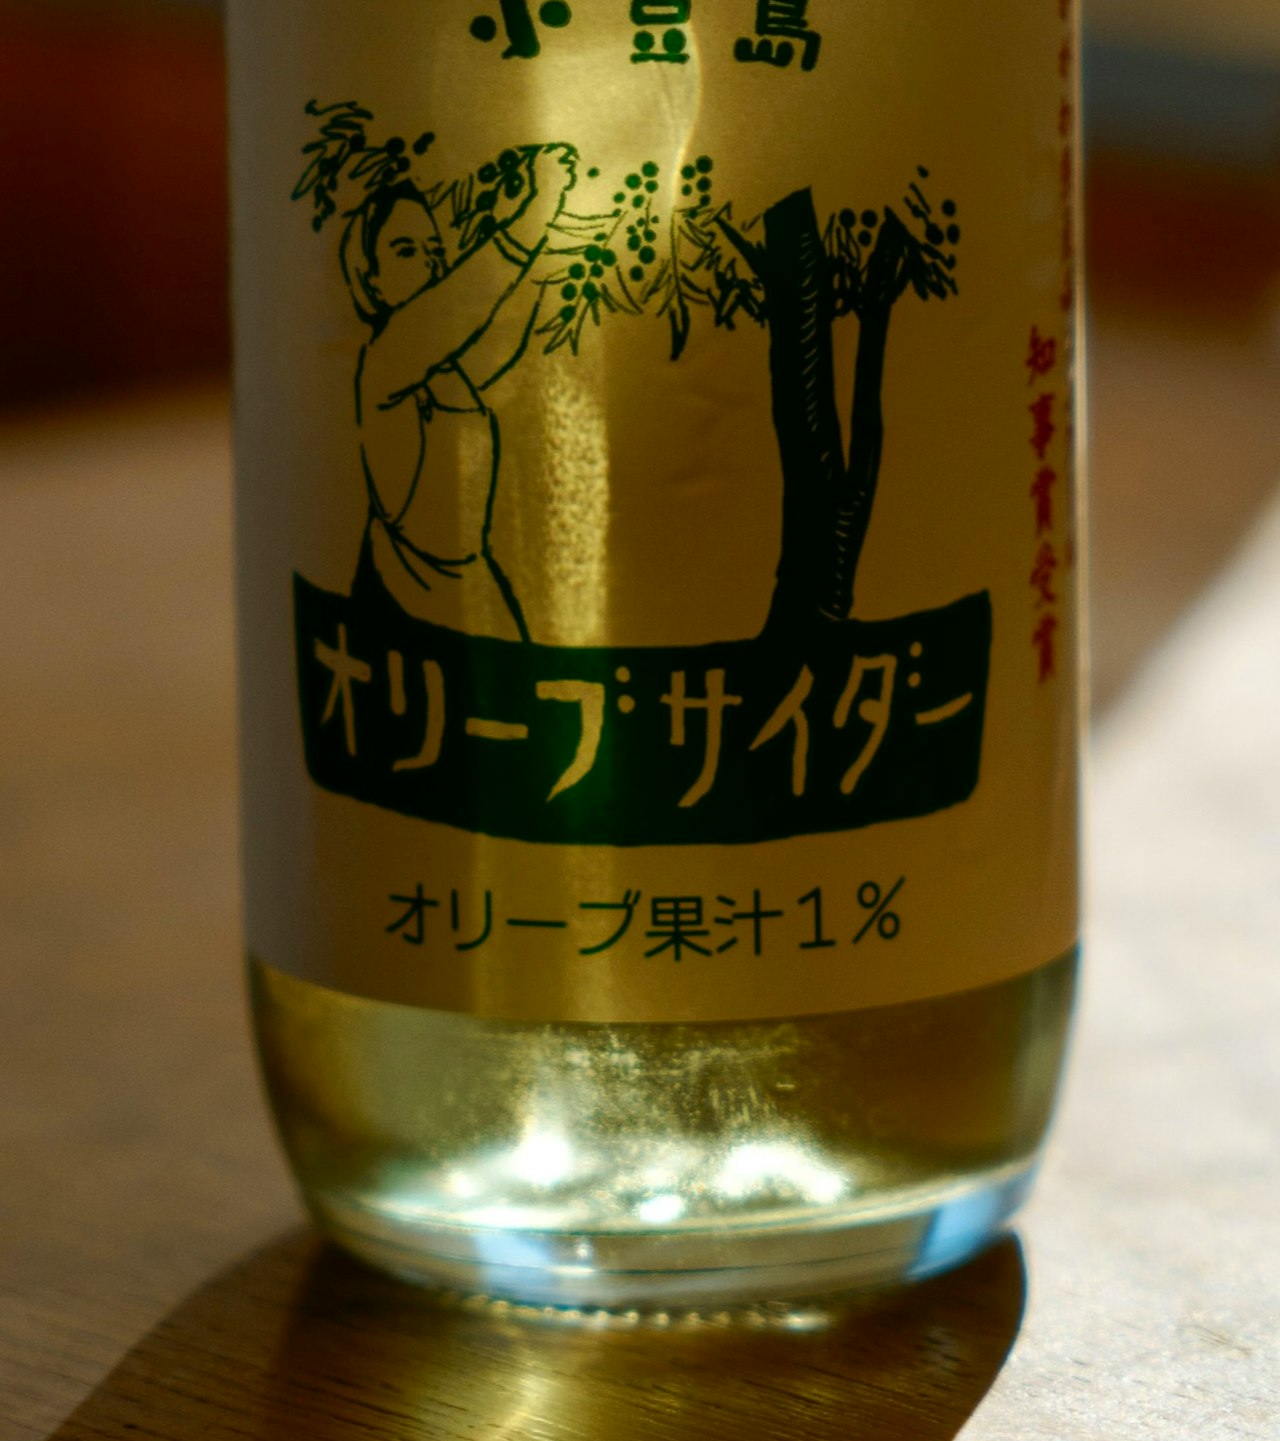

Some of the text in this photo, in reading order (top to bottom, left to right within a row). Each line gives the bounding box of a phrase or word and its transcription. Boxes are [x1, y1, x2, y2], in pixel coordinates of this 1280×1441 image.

[313, 622, 973, 809] オリーブサイダー
[385, 876, 906, 962] オリーブ果汁1%
